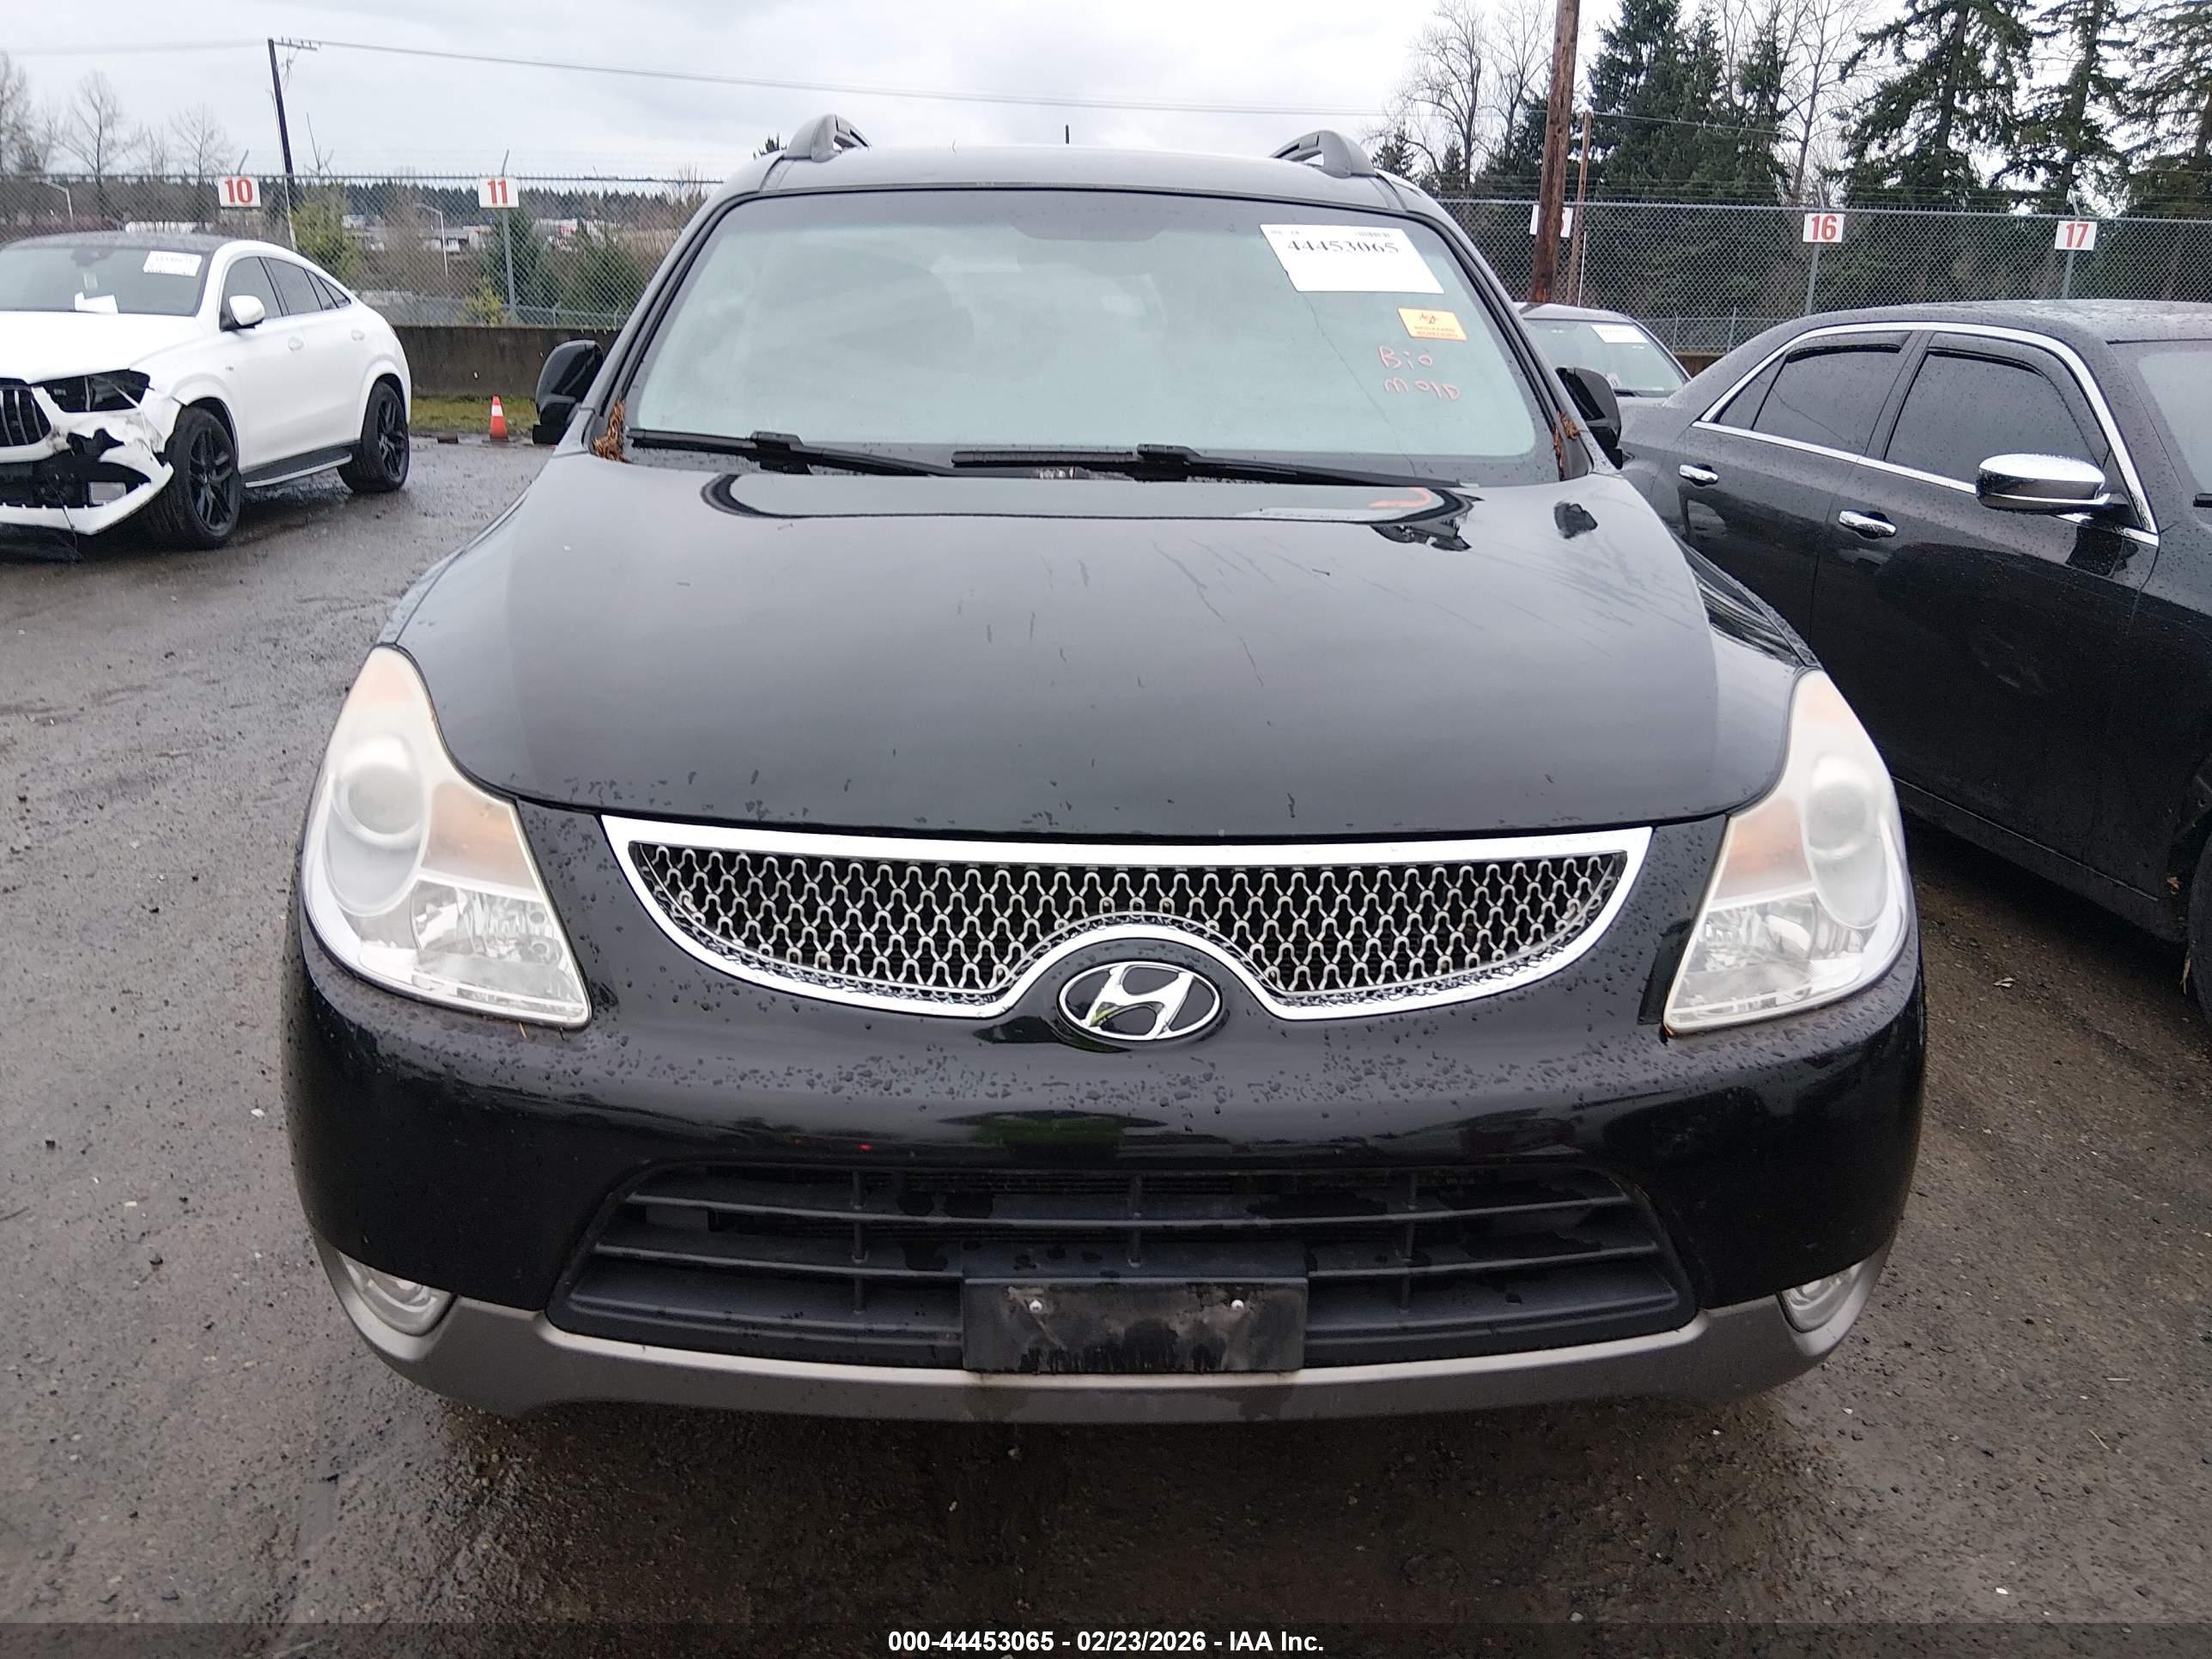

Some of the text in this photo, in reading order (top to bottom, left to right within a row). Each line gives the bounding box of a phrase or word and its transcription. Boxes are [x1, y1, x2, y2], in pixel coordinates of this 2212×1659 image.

[225, 178, 253, 204] 10
[487, 179, 508, 205] 11
[1811, 215, 1838, 241] 16
[2066, 222, 2089, 248] 17
[1287, 240, 1400, 254] 44453065
[1378, 345, 1433, 370] Bio
